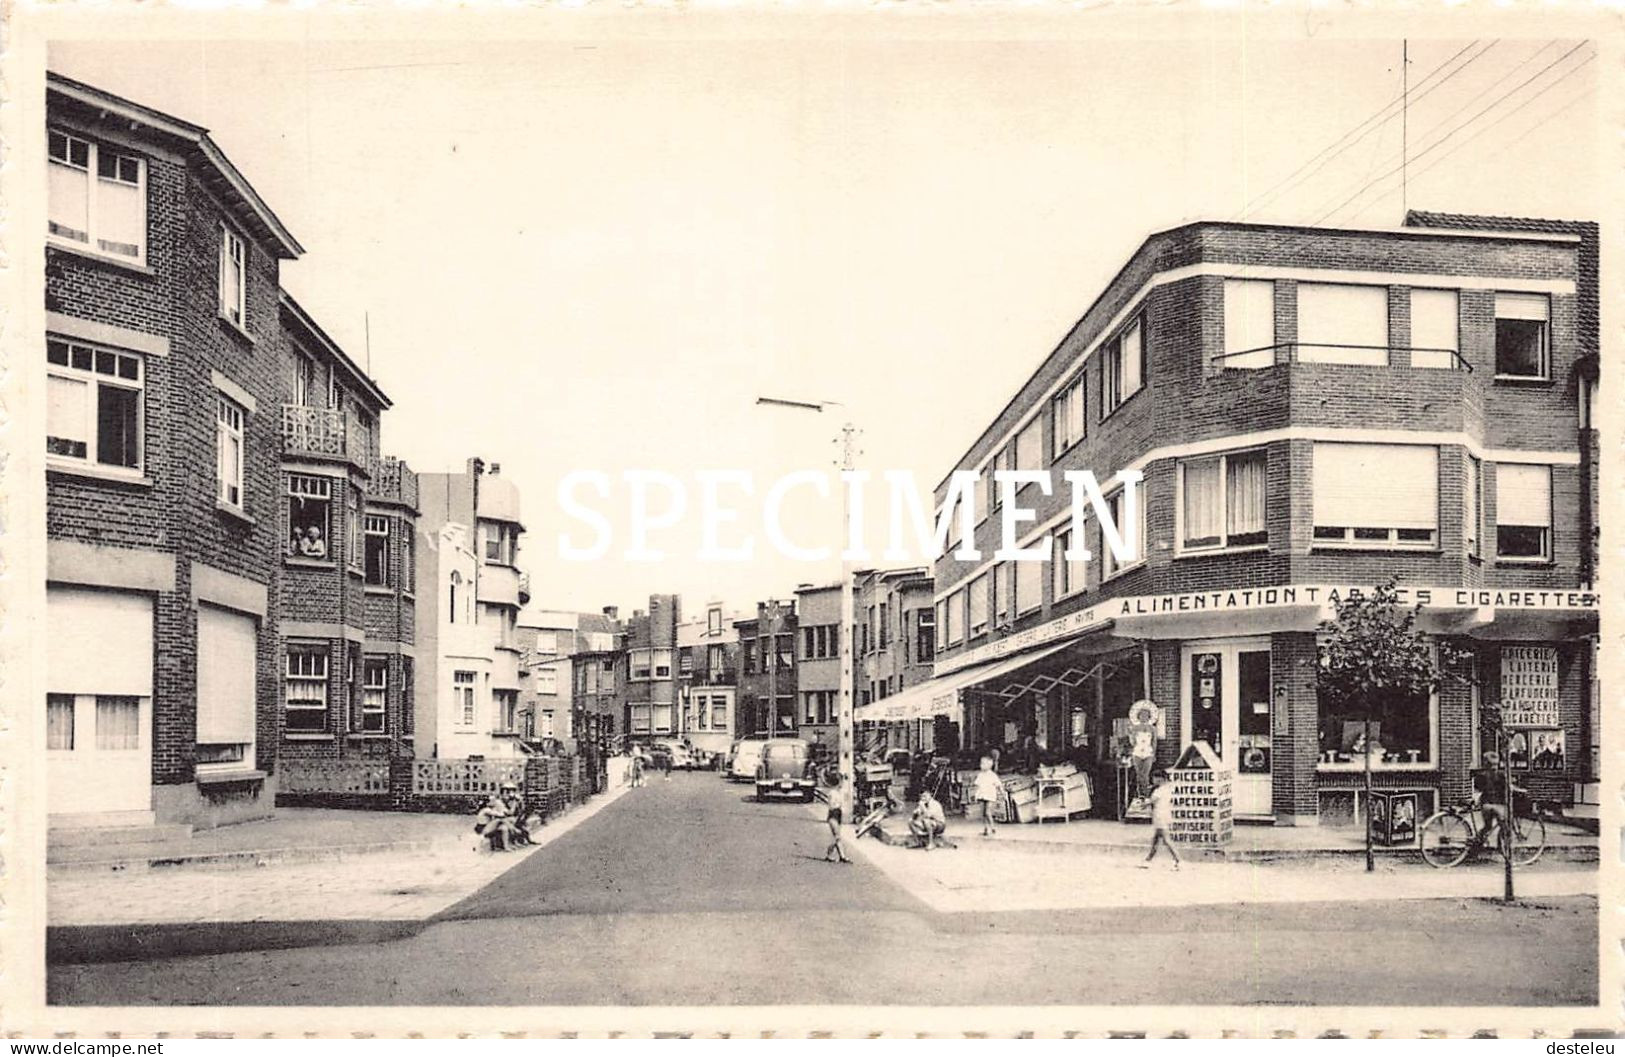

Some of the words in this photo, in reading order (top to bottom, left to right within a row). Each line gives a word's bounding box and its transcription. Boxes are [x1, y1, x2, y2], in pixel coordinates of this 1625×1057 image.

[1121, 588, 1296, 614] ALIMENTATION
[1305, 587, 1431, 604] TABCS
[1456, 591, 1593, 606] CIGARETTES
[1510, 662, 1556, 672] LAITERIE
[1503, 675, 1550, 685] MERCERIE
[1171, 786, 1214, 794] AITERIE
[1171, 810, 1215, 819] ERCERIE
